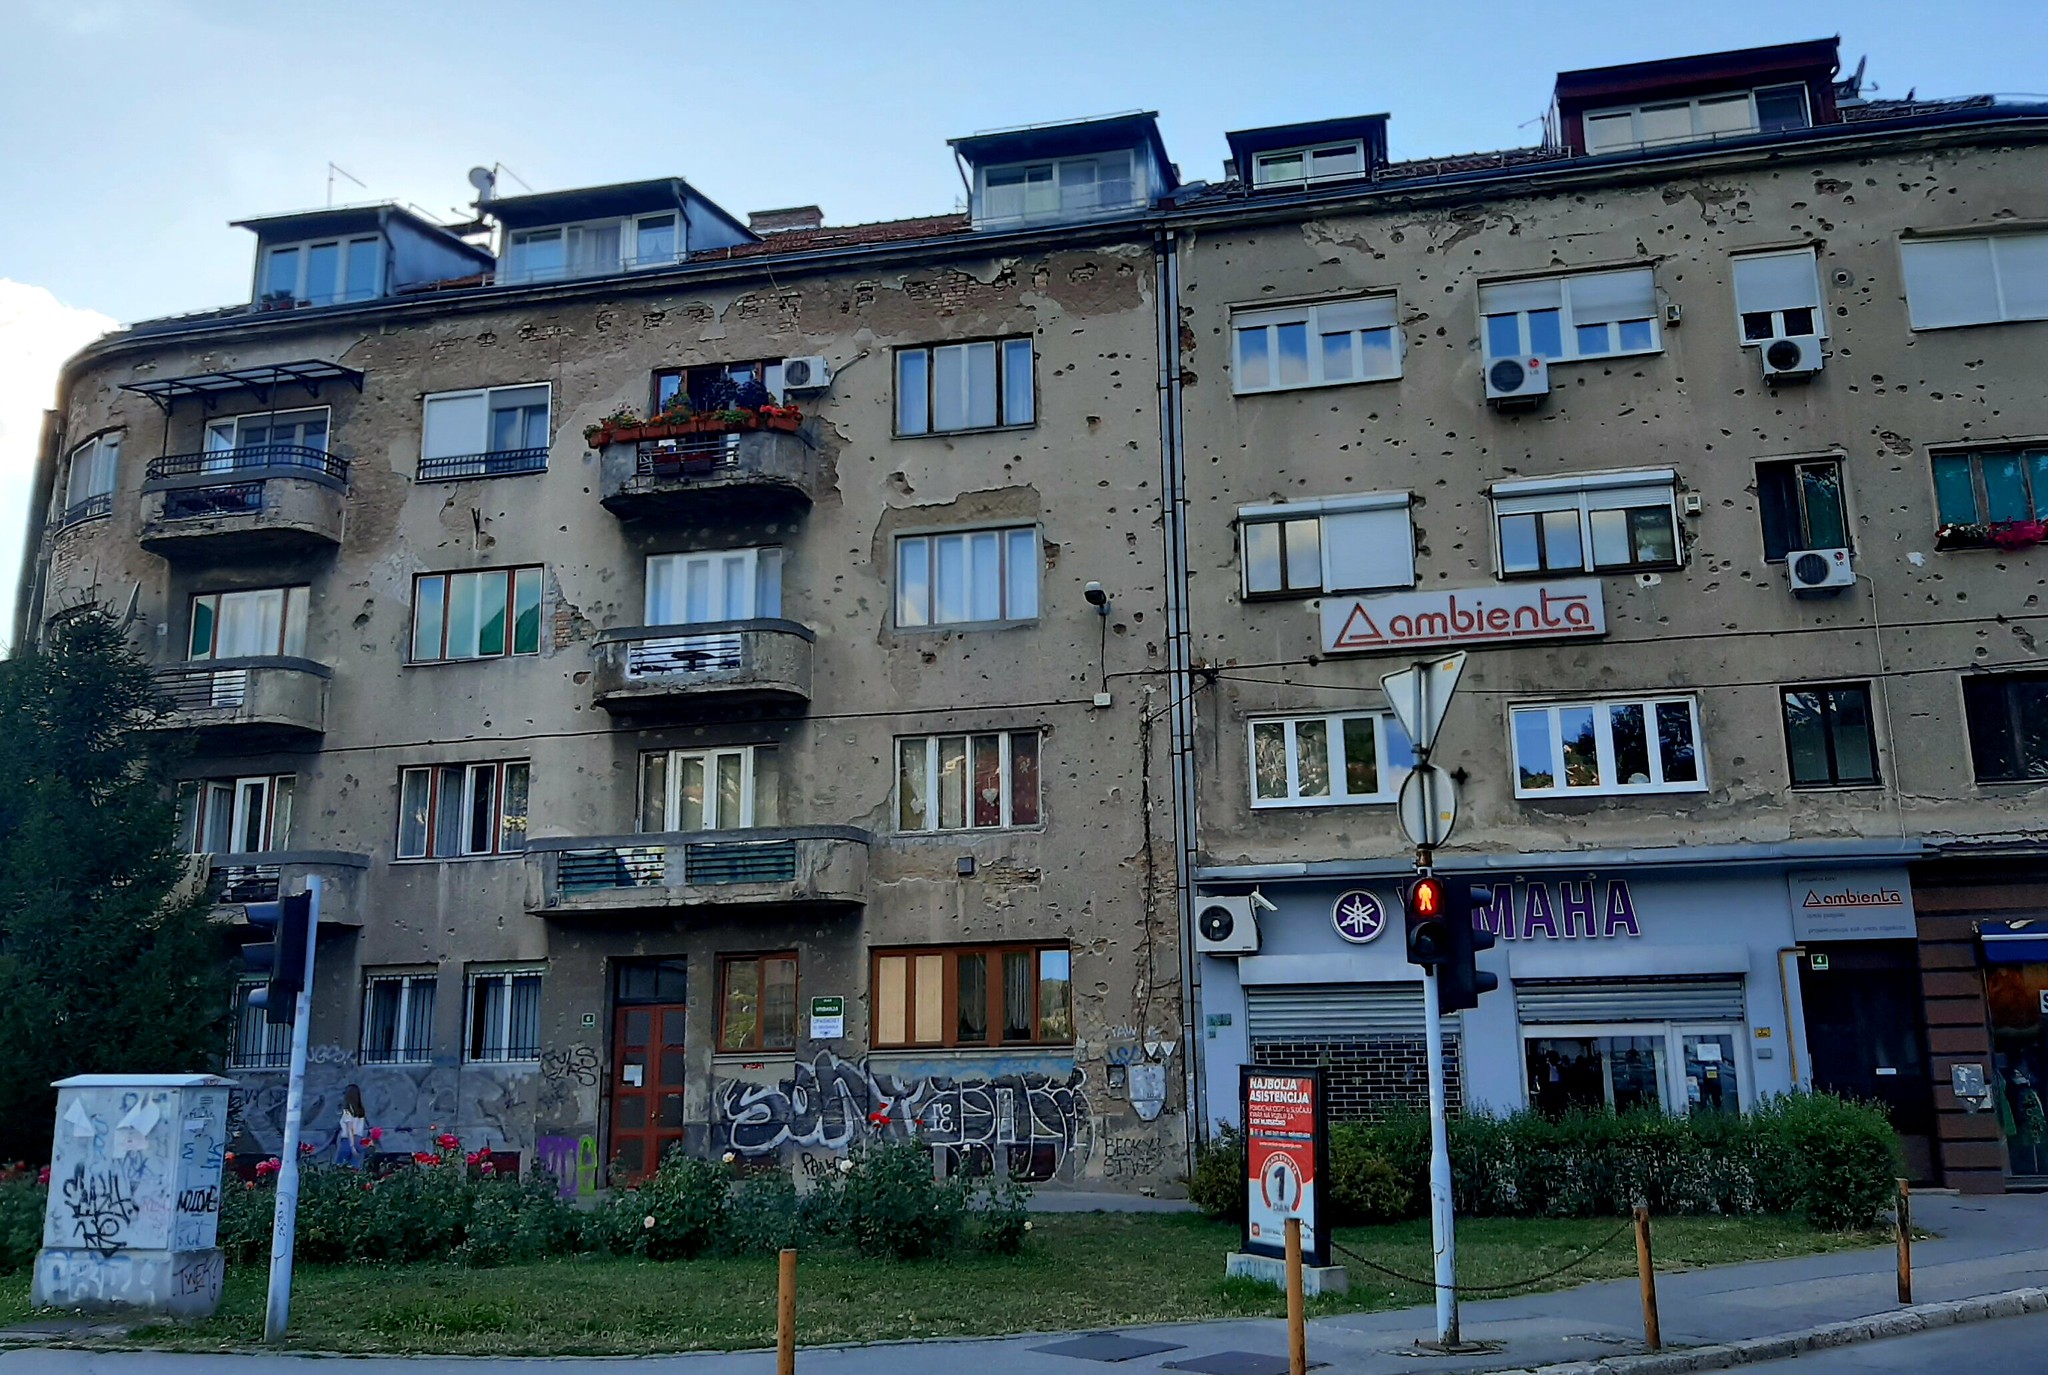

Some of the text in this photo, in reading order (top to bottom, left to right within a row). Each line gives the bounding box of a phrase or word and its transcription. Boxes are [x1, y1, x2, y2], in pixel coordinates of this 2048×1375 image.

[1388, 588, 1591, 640] ambienta
[1823, 886, 1902, 905] ambienta
[1395, 879, 1642, 940] MAHA
[1816, 955, 1823, 964] 4
[1249, 1077, 1298, 1091] NAJBOLJA
[1249, 1090, 1310, 1104] ASISTENCIJA
[1273, 1166, 1286, 1202] 1
[1272, 1202, 1291, 1213] DAN
